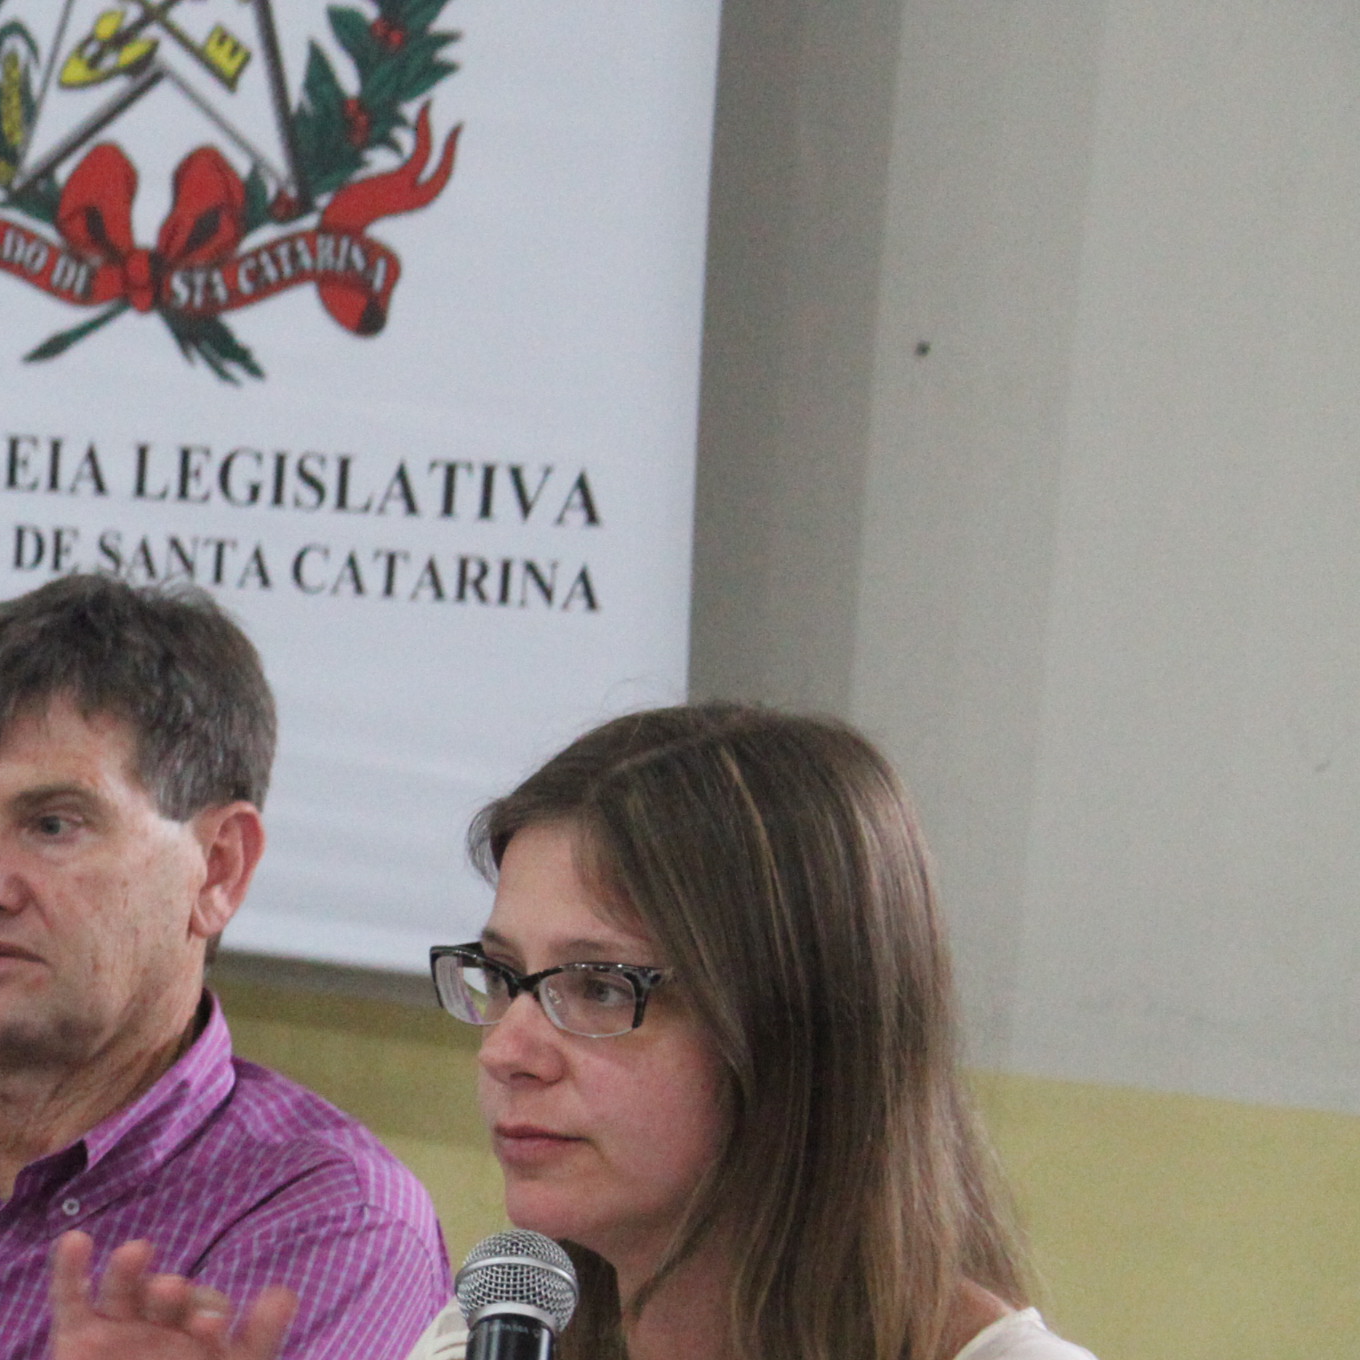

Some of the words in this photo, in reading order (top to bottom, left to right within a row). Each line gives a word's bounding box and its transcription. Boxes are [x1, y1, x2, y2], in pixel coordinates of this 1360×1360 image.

[237, 232, 387, 292] CATARINA
[132, 440, 602, 528] LEGISLATIVA
[11, 522, 80, 573] DE
[95, 529, 273, 591] SANTA
[290, 542, 602, 613] CATARINA
